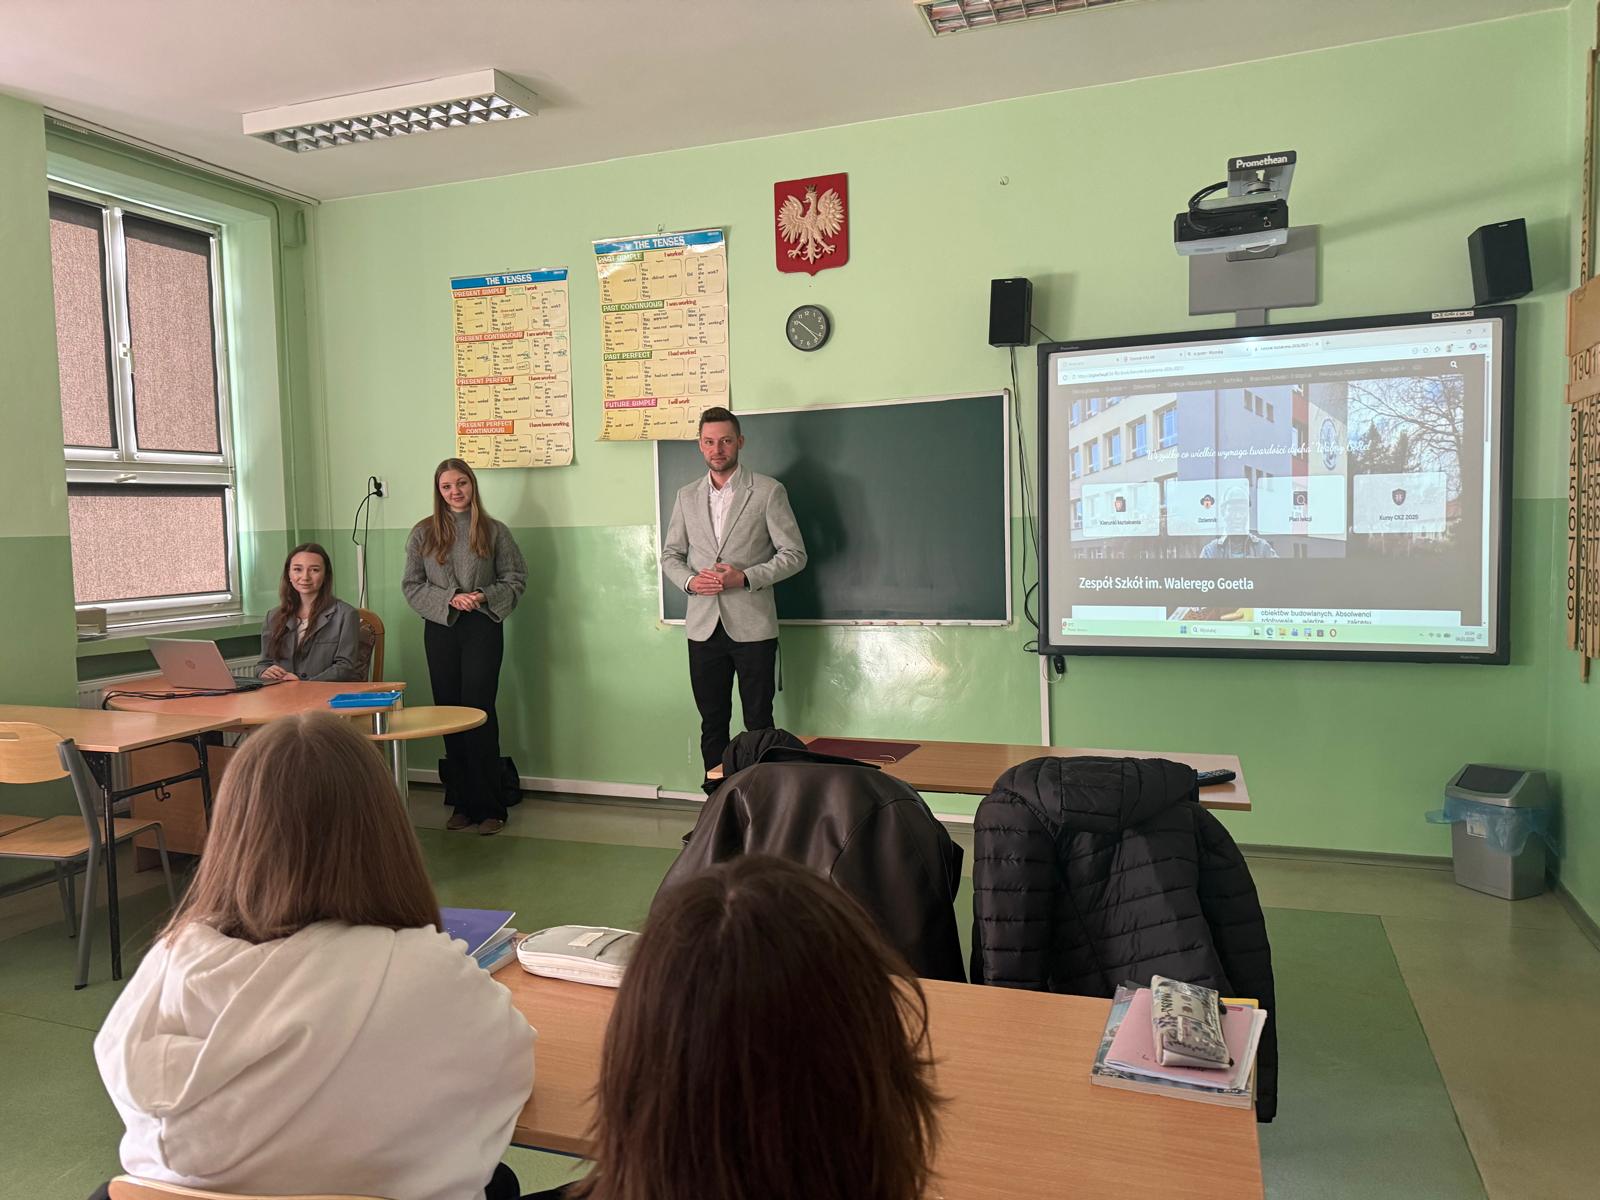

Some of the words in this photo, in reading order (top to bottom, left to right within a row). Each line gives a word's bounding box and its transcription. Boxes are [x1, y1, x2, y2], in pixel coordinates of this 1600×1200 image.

[1235, 154, 1288, 169] Promethean
[633, 240, 650, 249] THE
[652, 236, 685, 248] TENSES
[485, 276, 501, 286] THE
[502, 274, 532, 284] TENSES
[482, 287, 505, 295] SIMPLE
[620, 301, 663, 310] CONTINUOUS
[484, 332, 523, 340] CONTINUOUS
[622, 351, 650, 359] PERFECT
[1570, 417, 1577, 442] 3
[1570, 447, 1577, 472] 4
[1568, 476, 1576, 502] 5
[1568, 506, 1576, 532] 6
[1568, 536, 1576, 561] 7
[1079, 576, 1113, 591] Zespół
[1115, 576, 1144, 589] Szkół
[1145, 577, 1162, 589] im.
[1164, 577, 1215, 592] Walerego
[1217, 577, 1254, 590] Goetla
[1568, 566, 1575, 590] 8
[1260, 610, 1290, 618] obiektów
[1568, 596, 1574, 620] 9
